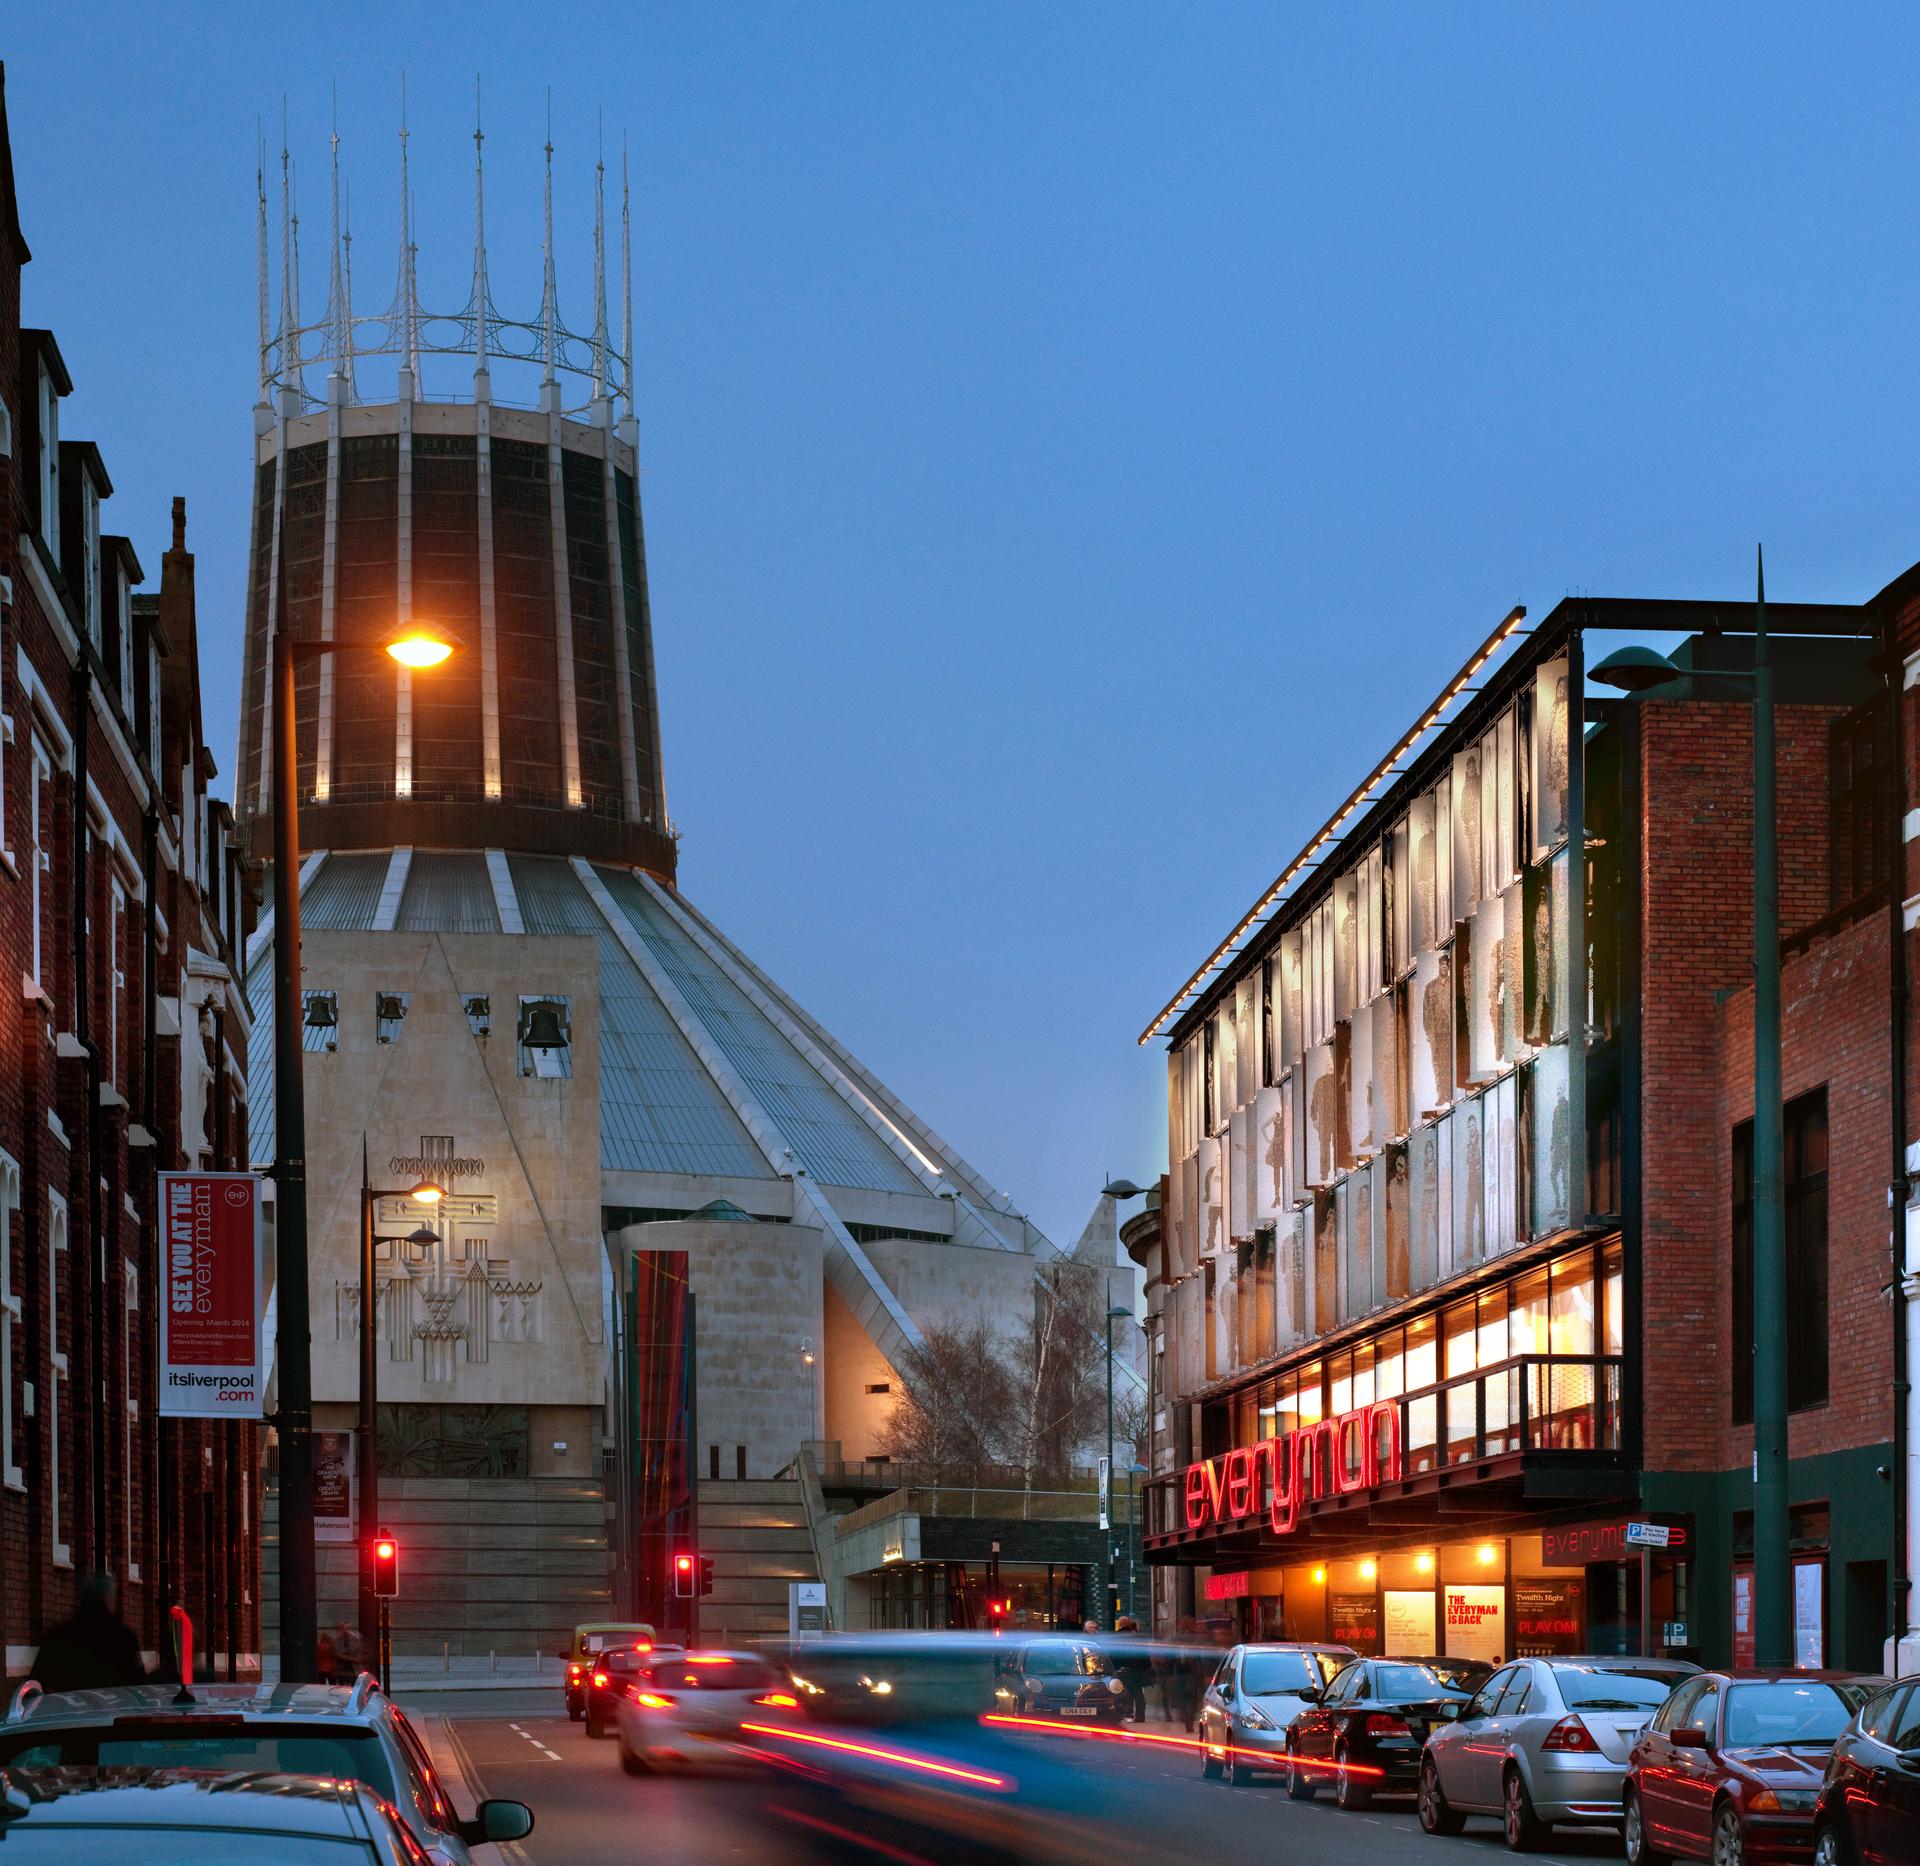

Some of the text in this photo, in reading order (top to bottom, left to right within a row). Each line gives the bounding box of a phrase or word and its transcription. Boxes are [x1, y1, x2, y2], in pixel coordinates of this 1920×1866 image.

[170, 1182, 193, 1313] SEE YOU AT THE
[195, 1183, 216, 1314] everyman
[172, 1319, 204, 1327] Opening
[168, 1372, 254, 1390] itsliverpool
[215, 1391, 254, 1402] .com
[1185, 1399, 1402, 1535] everyman
[1448, 1595, 1465, 1605] THE
[1545, 1594, 1565, 1602] Night
[1447, 1605, 1498, 1615] EVERYMAN
[1448, 1615, 1482, 1625] IS BACK
[1519, 1620, 1552, 1634] PLAY
[1673, 1623, 1684, 1636] P
